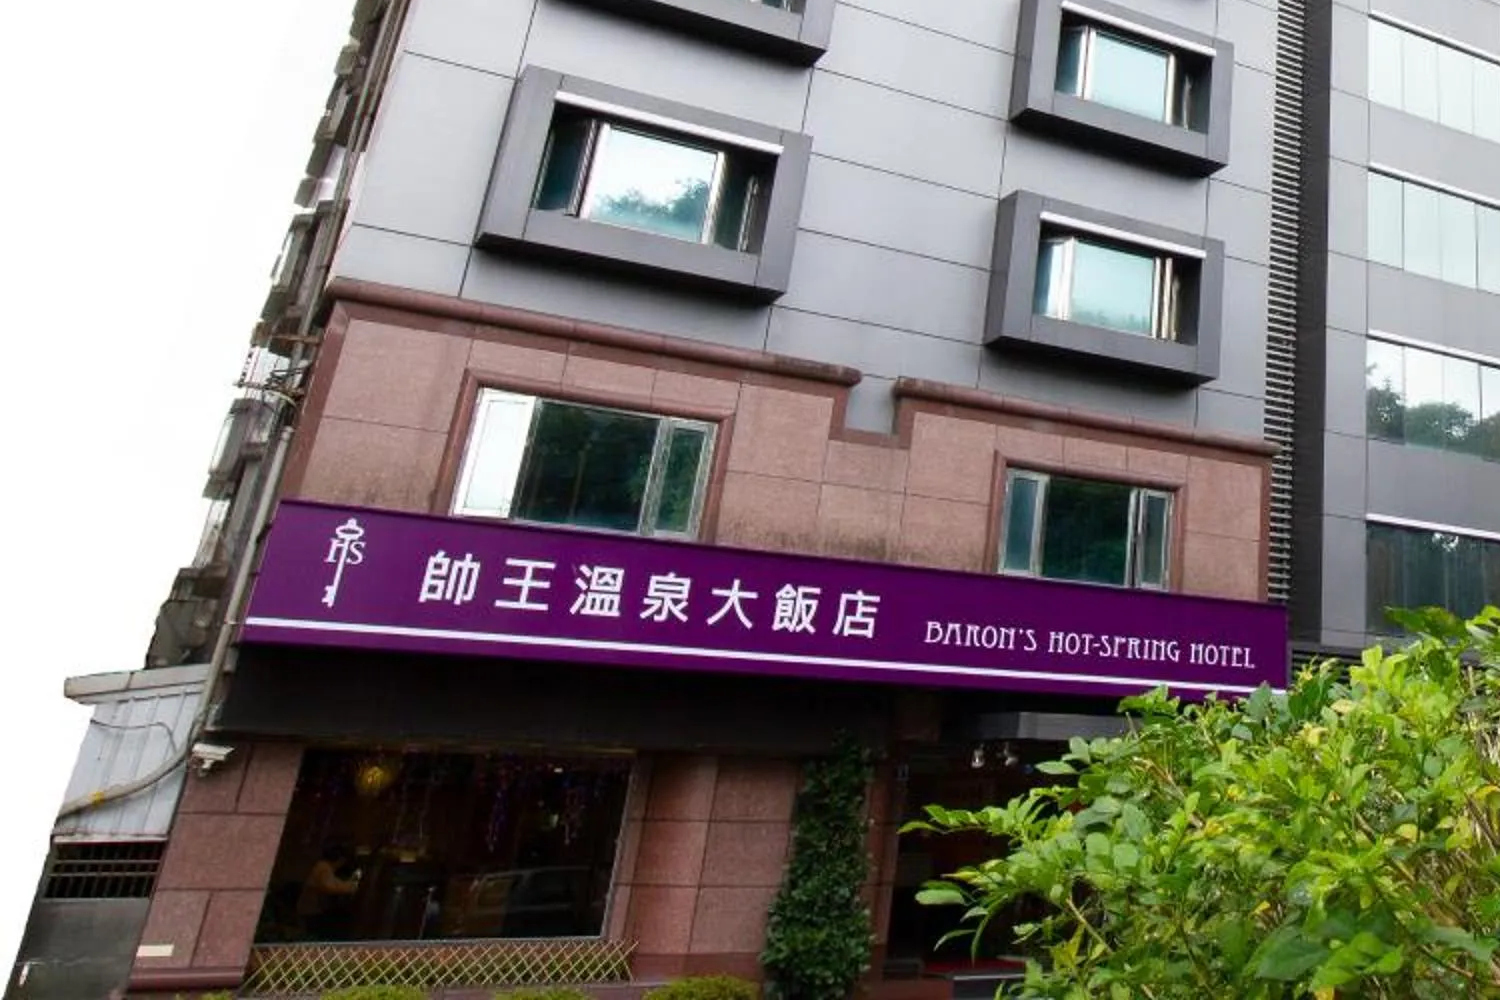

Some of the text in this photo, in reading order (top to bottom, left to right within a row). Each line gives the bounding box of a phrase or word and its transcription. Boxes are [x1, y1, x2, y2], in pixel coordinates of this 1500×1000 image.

[417, 549, 882, 640] 帥王溫泉大飯店
[924, 620, 1256, 669] BARON'S HOT-SPRING HOTEL
